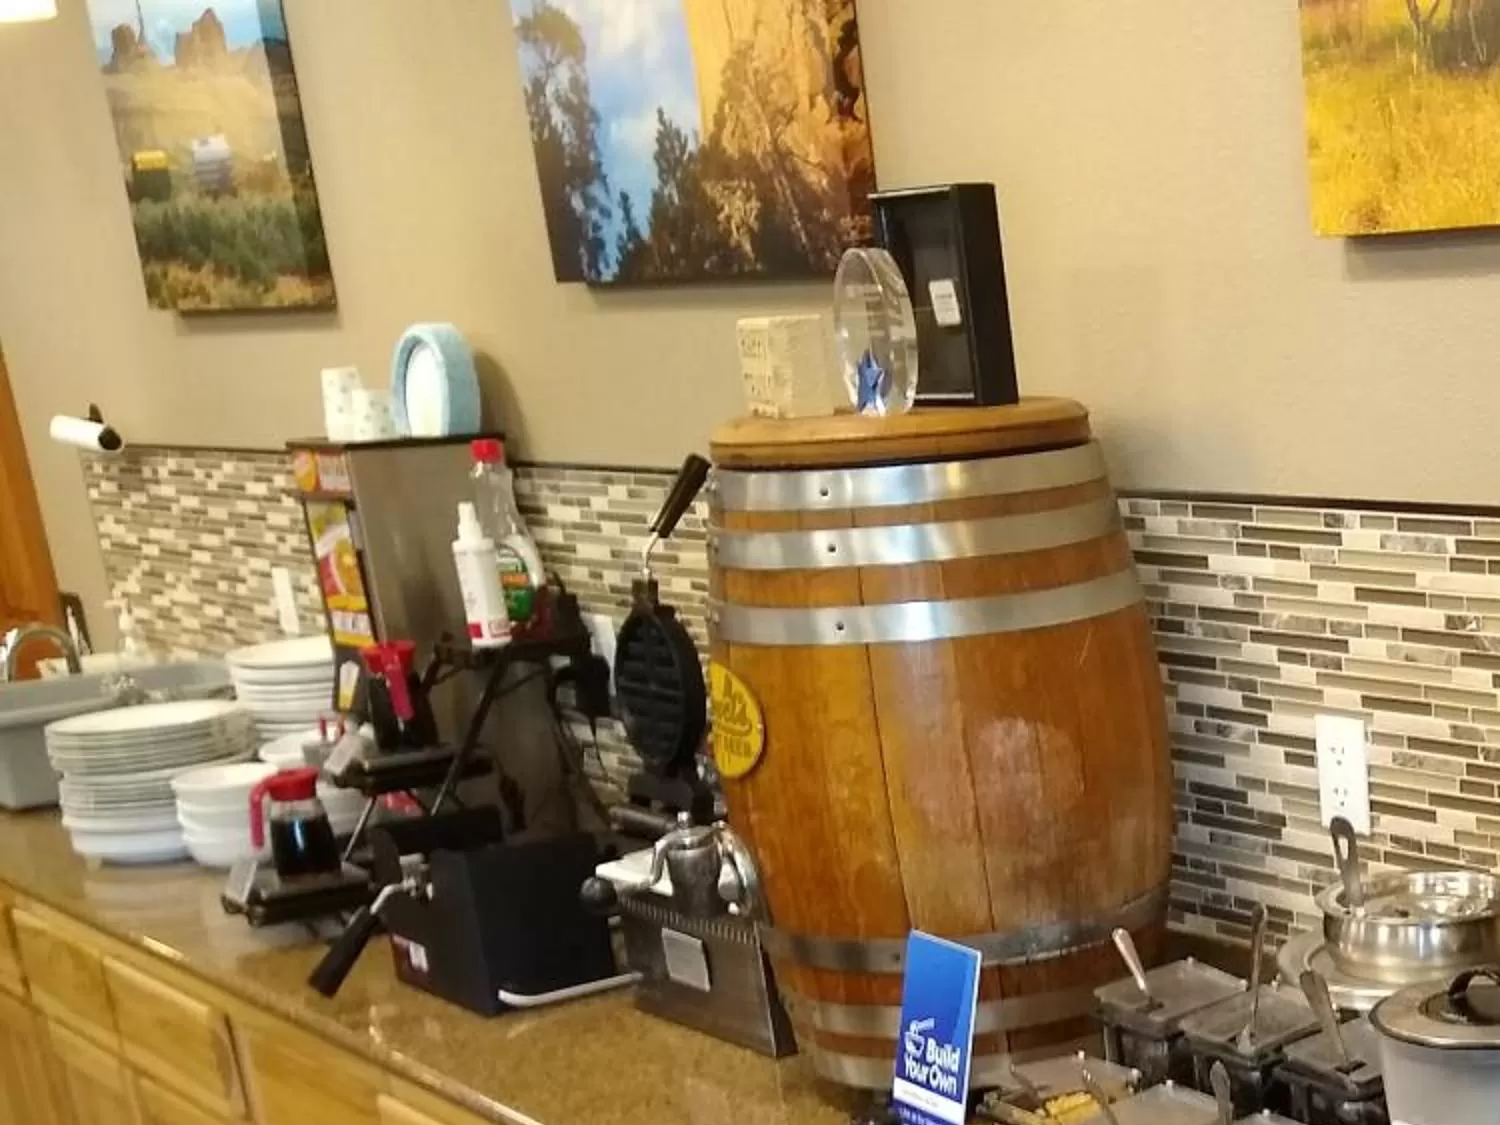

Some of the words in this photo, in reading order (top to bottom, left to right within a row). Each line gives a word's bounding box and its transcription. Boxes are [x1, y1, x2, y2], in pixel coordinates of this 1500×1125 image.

[904, 1052, 929, 1084] Your
[929, 1064, 958, 1096] Own
[926, 1037, 961, 1074] Build
